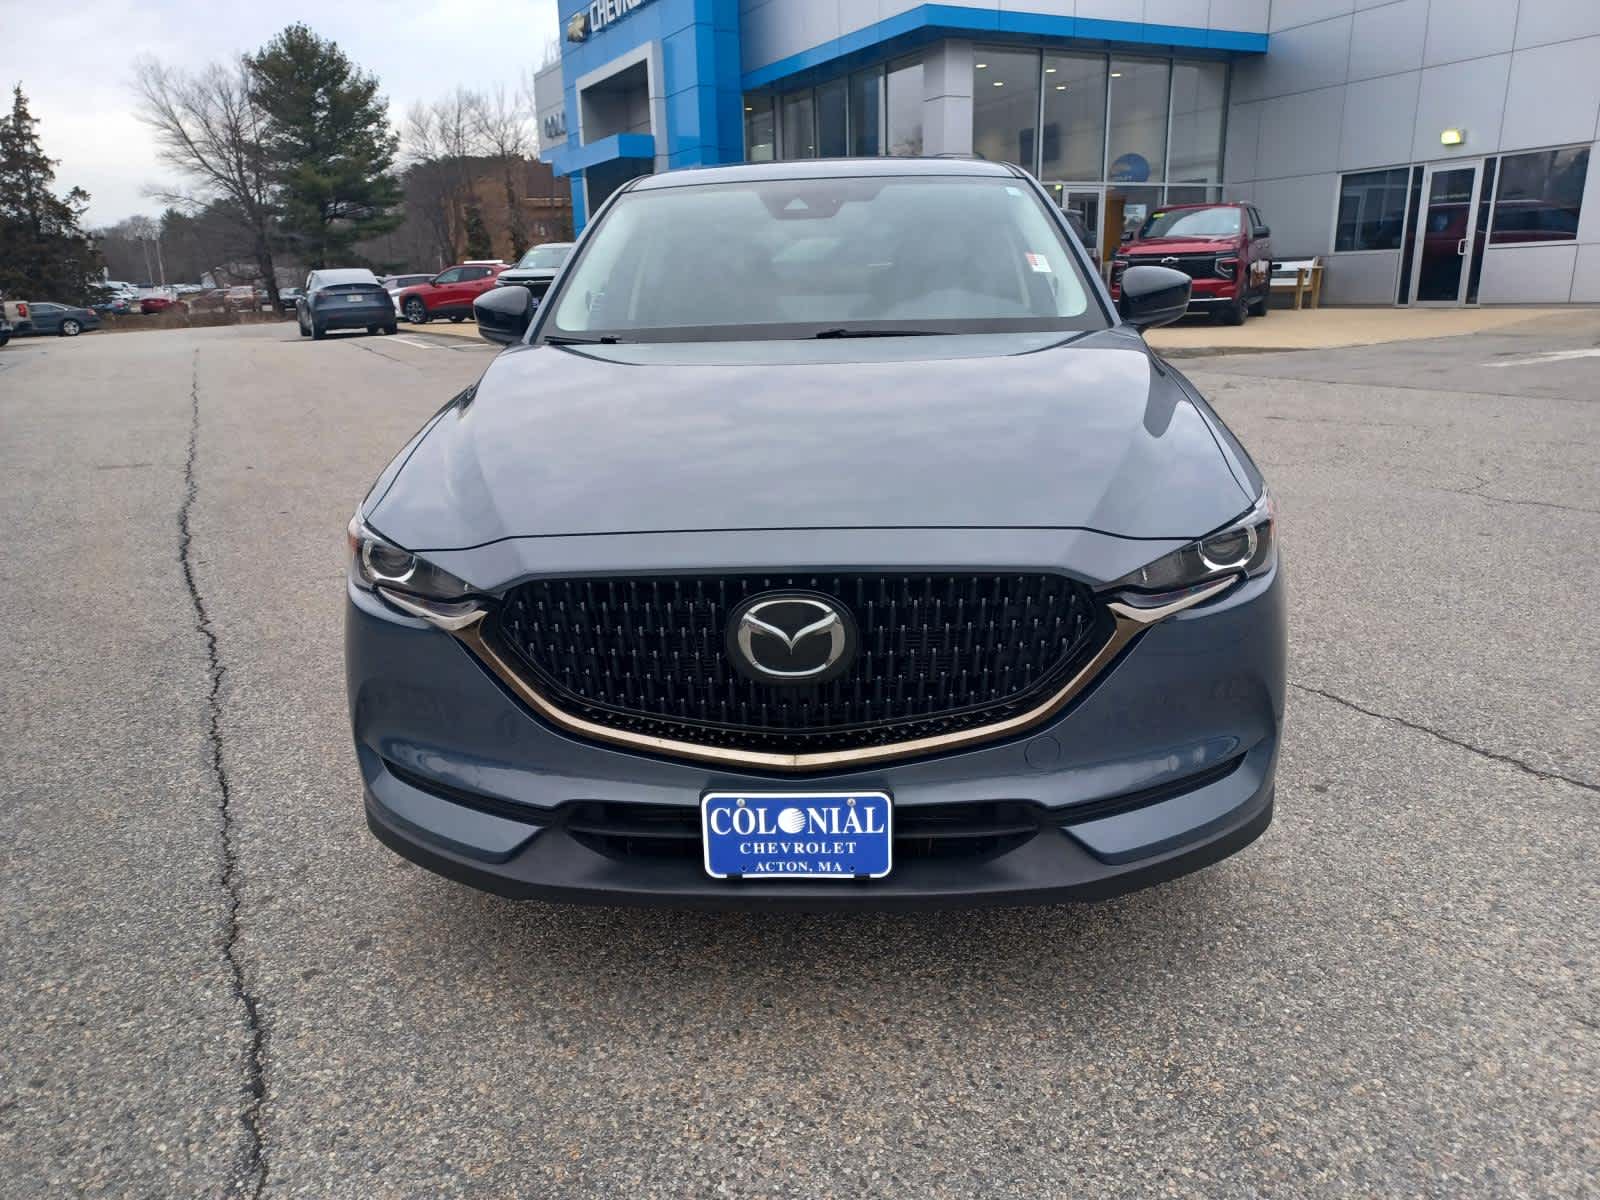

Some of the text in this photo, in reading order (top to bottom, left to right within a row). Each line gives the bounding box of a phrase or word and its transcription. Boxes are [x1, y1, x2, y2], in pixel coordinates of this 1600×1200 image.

[710, 807, 885, 836] COLONIAL
[739, 842, 857, 855] CHEVROLET
[755, 861, 843, 872] ACTON, MA
